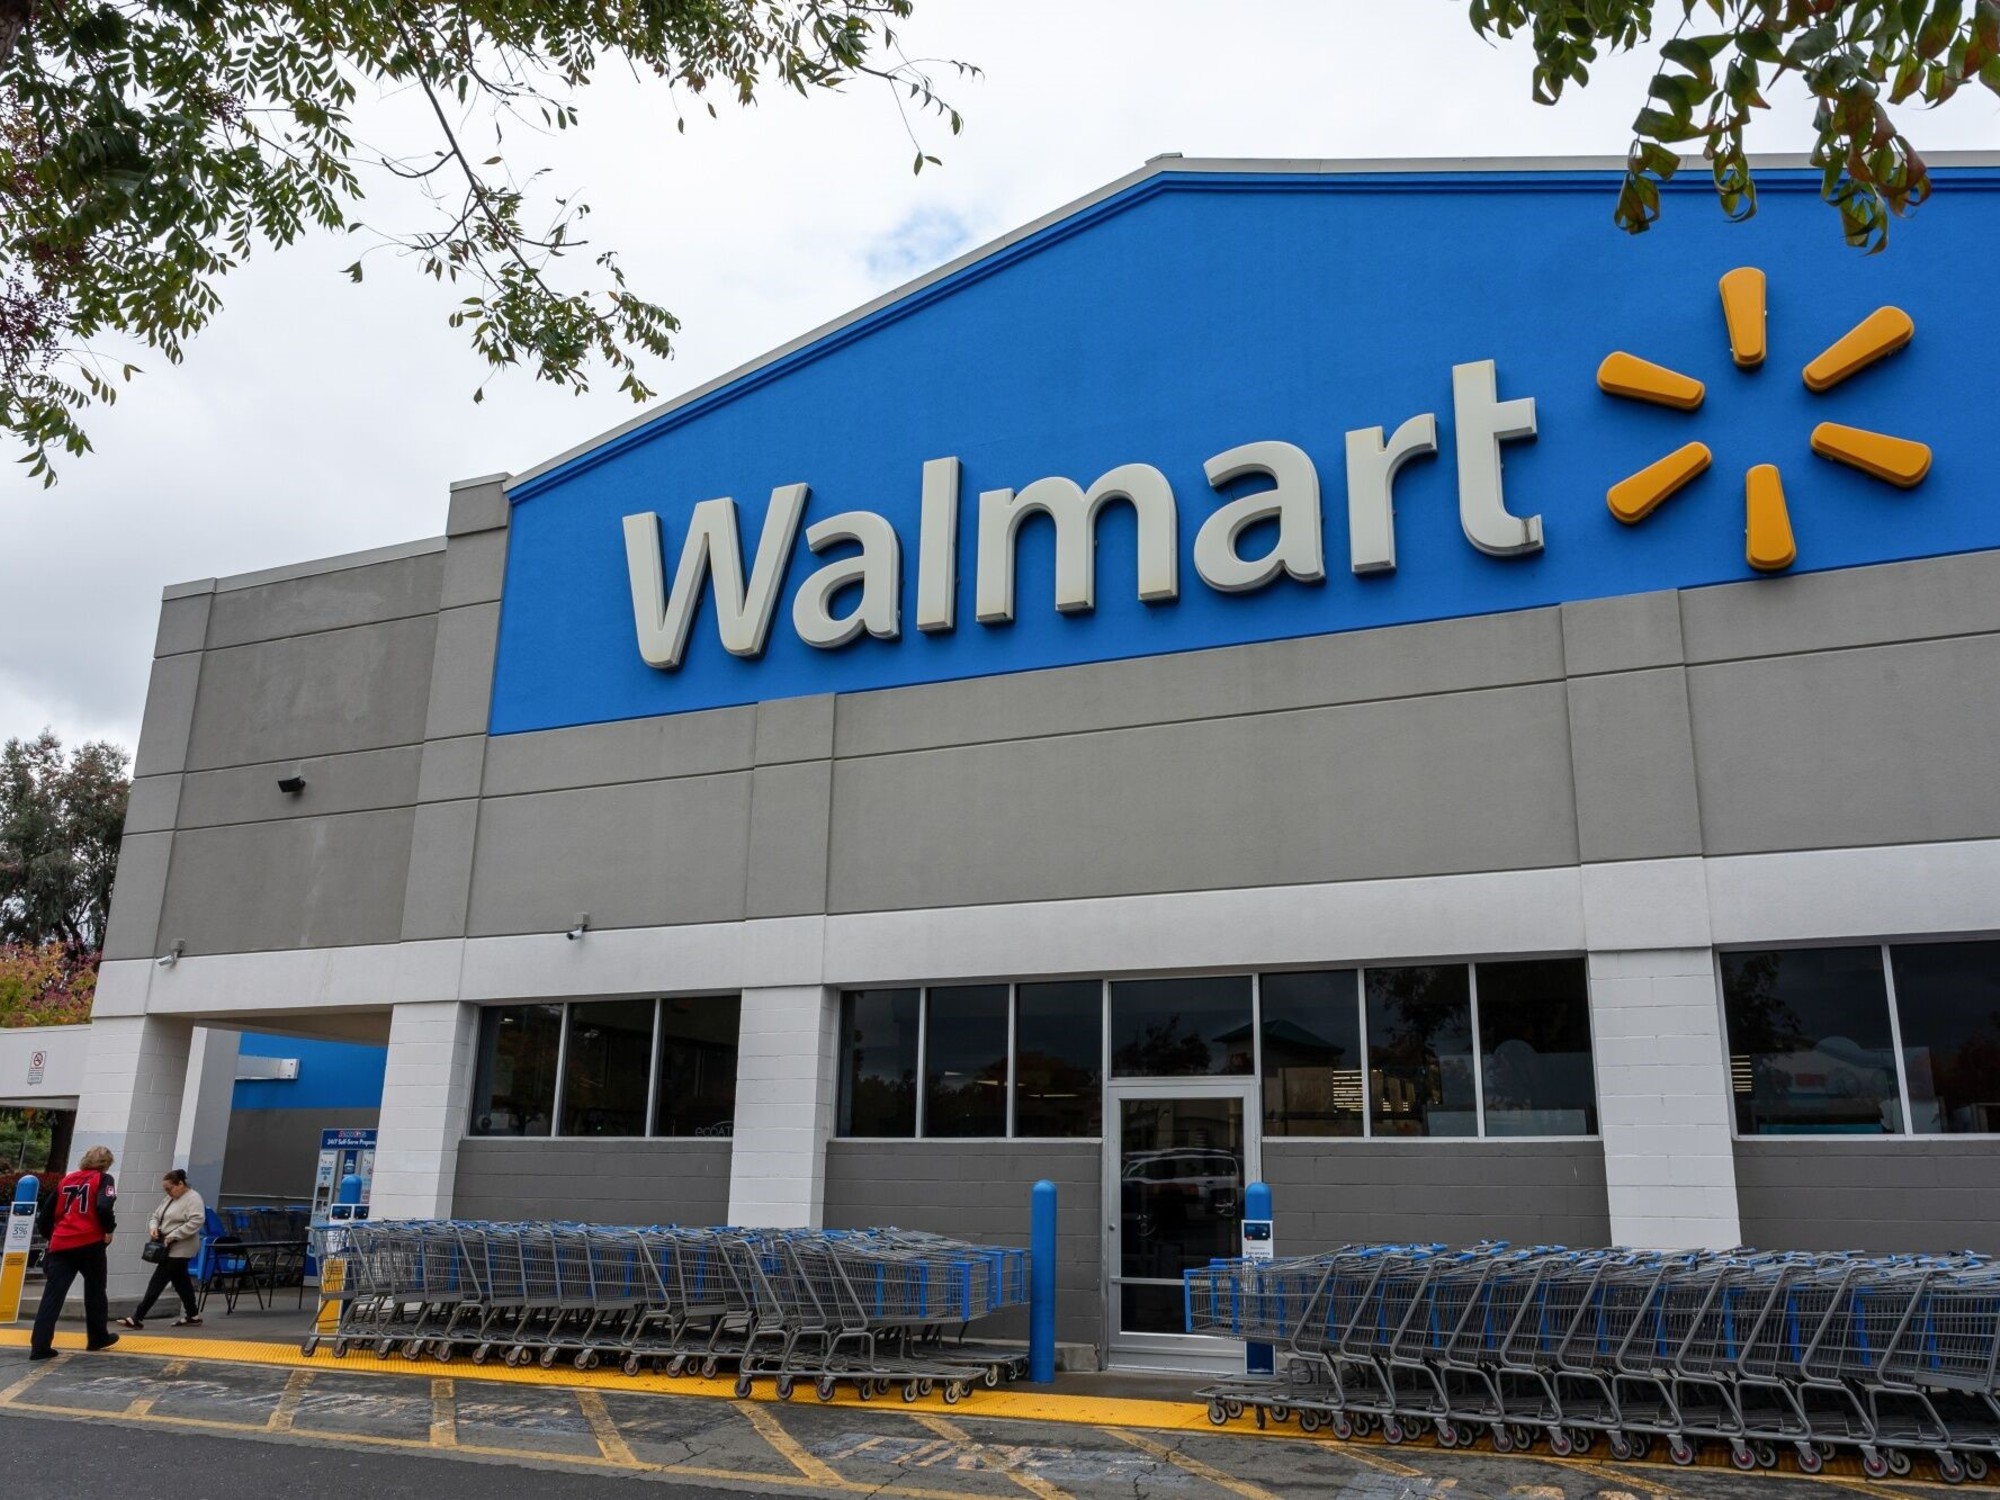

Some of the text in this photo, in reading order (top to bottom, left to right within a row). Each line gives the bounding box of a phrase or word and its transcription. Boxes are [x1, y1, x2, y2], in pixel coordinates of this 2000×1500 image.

[621, 358, 1545, 670] Walmart
[62, 1183, 91, 1216] 71
[12, 1226, 28, 1235] 3%
